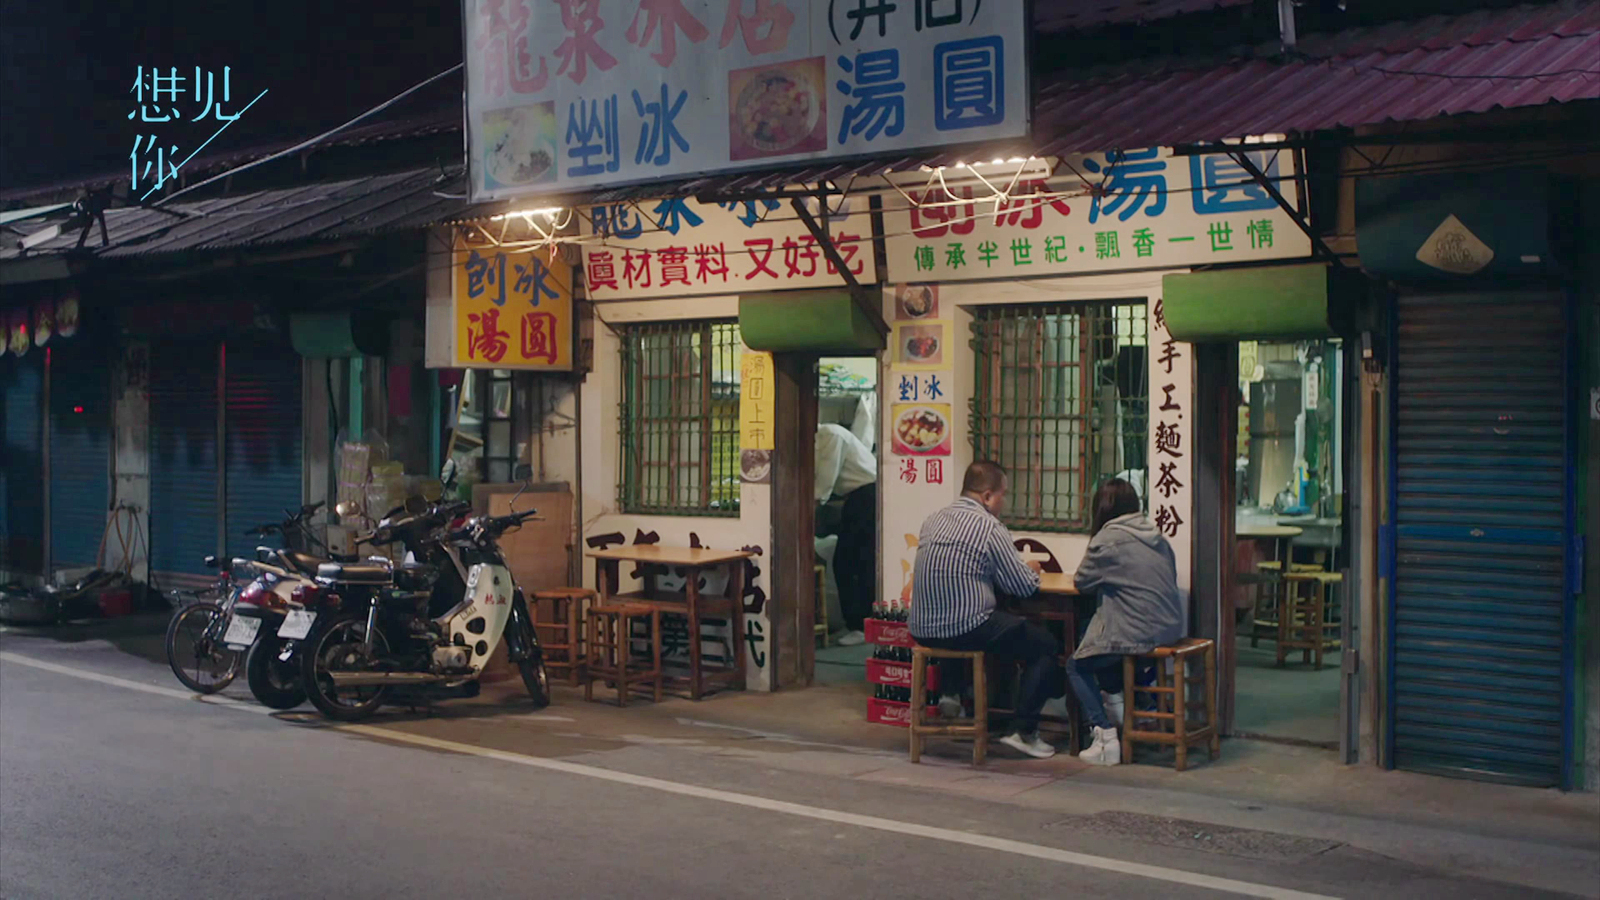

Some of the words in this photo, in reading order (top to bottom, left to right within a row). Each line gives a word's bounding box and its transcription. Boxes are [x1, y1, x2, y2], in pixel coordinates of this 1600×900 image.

[565, 83, 690, 178] 剉冰
[836, 35, 1005, 145] 湯圓
[465, 250, 560, 306] 刨冰
[467, 308, 558, 365] 湯圓
[899, 458, 943, 485] 湯圓
